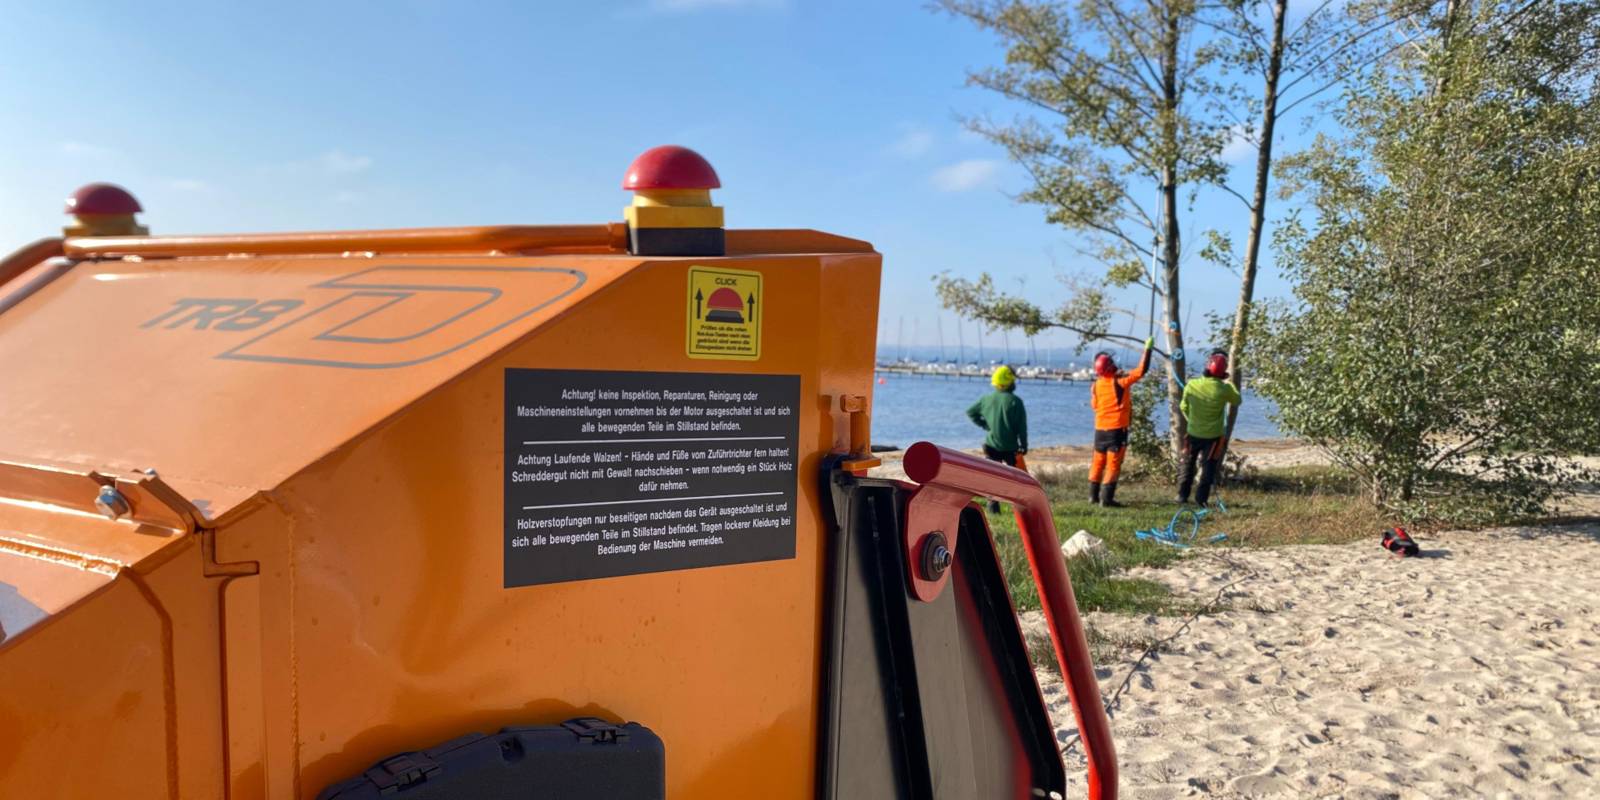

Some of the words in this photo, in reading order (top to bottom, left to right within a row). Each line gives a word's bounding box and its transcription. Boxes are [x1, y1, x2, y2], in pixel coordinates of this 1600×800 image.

[714, 277, 737, 286] CLICK
[139, 297, 305, 331] TR8
[561, 388, 596, 402] Achtung!
[598, 390, 619, 401] keine
[621, 389, 662, 402] Inspektion,
[663, 389, 707, 402] Reparaturen,
[708, 390, 741, 402] Reinigung
[742, 391, 758, 401] oder
[517, 405, 611, 418] Maschineneinstellungen
[613, 406, 654, 416] vornehmen
[656, 406, 668, 416] bis
[669, 406, 682, 416] der
[683, 405, 704, 416] Motor
[705, 406, 752, 418] ausgeschaltet
[753, 406, 763, 416] ist
[763, 406, 776, 416] und
[777, 406, 791, 416] sich
[581, 422, 596, 433] alle
[598, 421, 646, 434] bewegenden
[647, 421, 664, 432] Teile
[665, 421, 675, 431] im
[676, 420, 709, 432] Stillstand
[710, 420, 742, 431] befinden.
[517, 454, 552, 467] Achtung
[554, 453, 591, 464] Laufende
[593, 452, 622, 463] Walzen!
[631, 451, 654, 461] Hände
[656, 450, 671, 461] und
[672, 450, 689, 460] Füße
[691, 451, 706, 460] vom
[707, 448, 753, 460] Zuführtrichter
[754, 447, 767, 458] fern
[768, 447, 790, 457] halten!
[511, 470, 568, 483] Schreddergut
[569, 469, 590, 480] nicht
[591, 468, 604, 479] mit
[606, 467, 632, 479] Gewalt
[634, 466, 683, 477] nachschieben
[691, 465, 710, 475] wenn
[711, 463, 746, 475] notwendig
[747, 463, 758, 473] ein
[759, 461, 778, 473] Stück
[778, 462, 793, 472] Holz
[638, 481, 658, 492] dafür
[660, 480, 689, 491] nehmen.
[516, 515, 592, 530] Holzverstopfungen
[594, 515, 607, 525] nur
[609, 511, 648, 524] beseitigen
[649, 509, 682, 521] nachdem
[683, 507, 697, 518] das
[698, 506, 718, 518] Gerät
[719, 503, 764, 517] ausgeschaltet
[765, 502, 775, 513] ist
[775, 501, 788, 512] und
[511, 536, 530, 548] sich
[532, 534, 547, 546] alle
[549, 531, 600, 545] bewegenden
[601, 528, 619, 540] Teile
[621, 528, 631, 538] im
[632, 525, 667, 538] Stillstand
[668, 523, 699, 535] befindet.
[700, 522, 723, 534] Tragen
[724, 519, 751, 531] lockerer
[752, 518, 780, 529] Kleidung
[780, 516, 792, 526] bei
[597, 543, 637, 556] Bedienung
[638, 541, 652, 552] der
[653, 538, 686, 551] Maschine
[688, 536, 724, 547] vermeiden.
